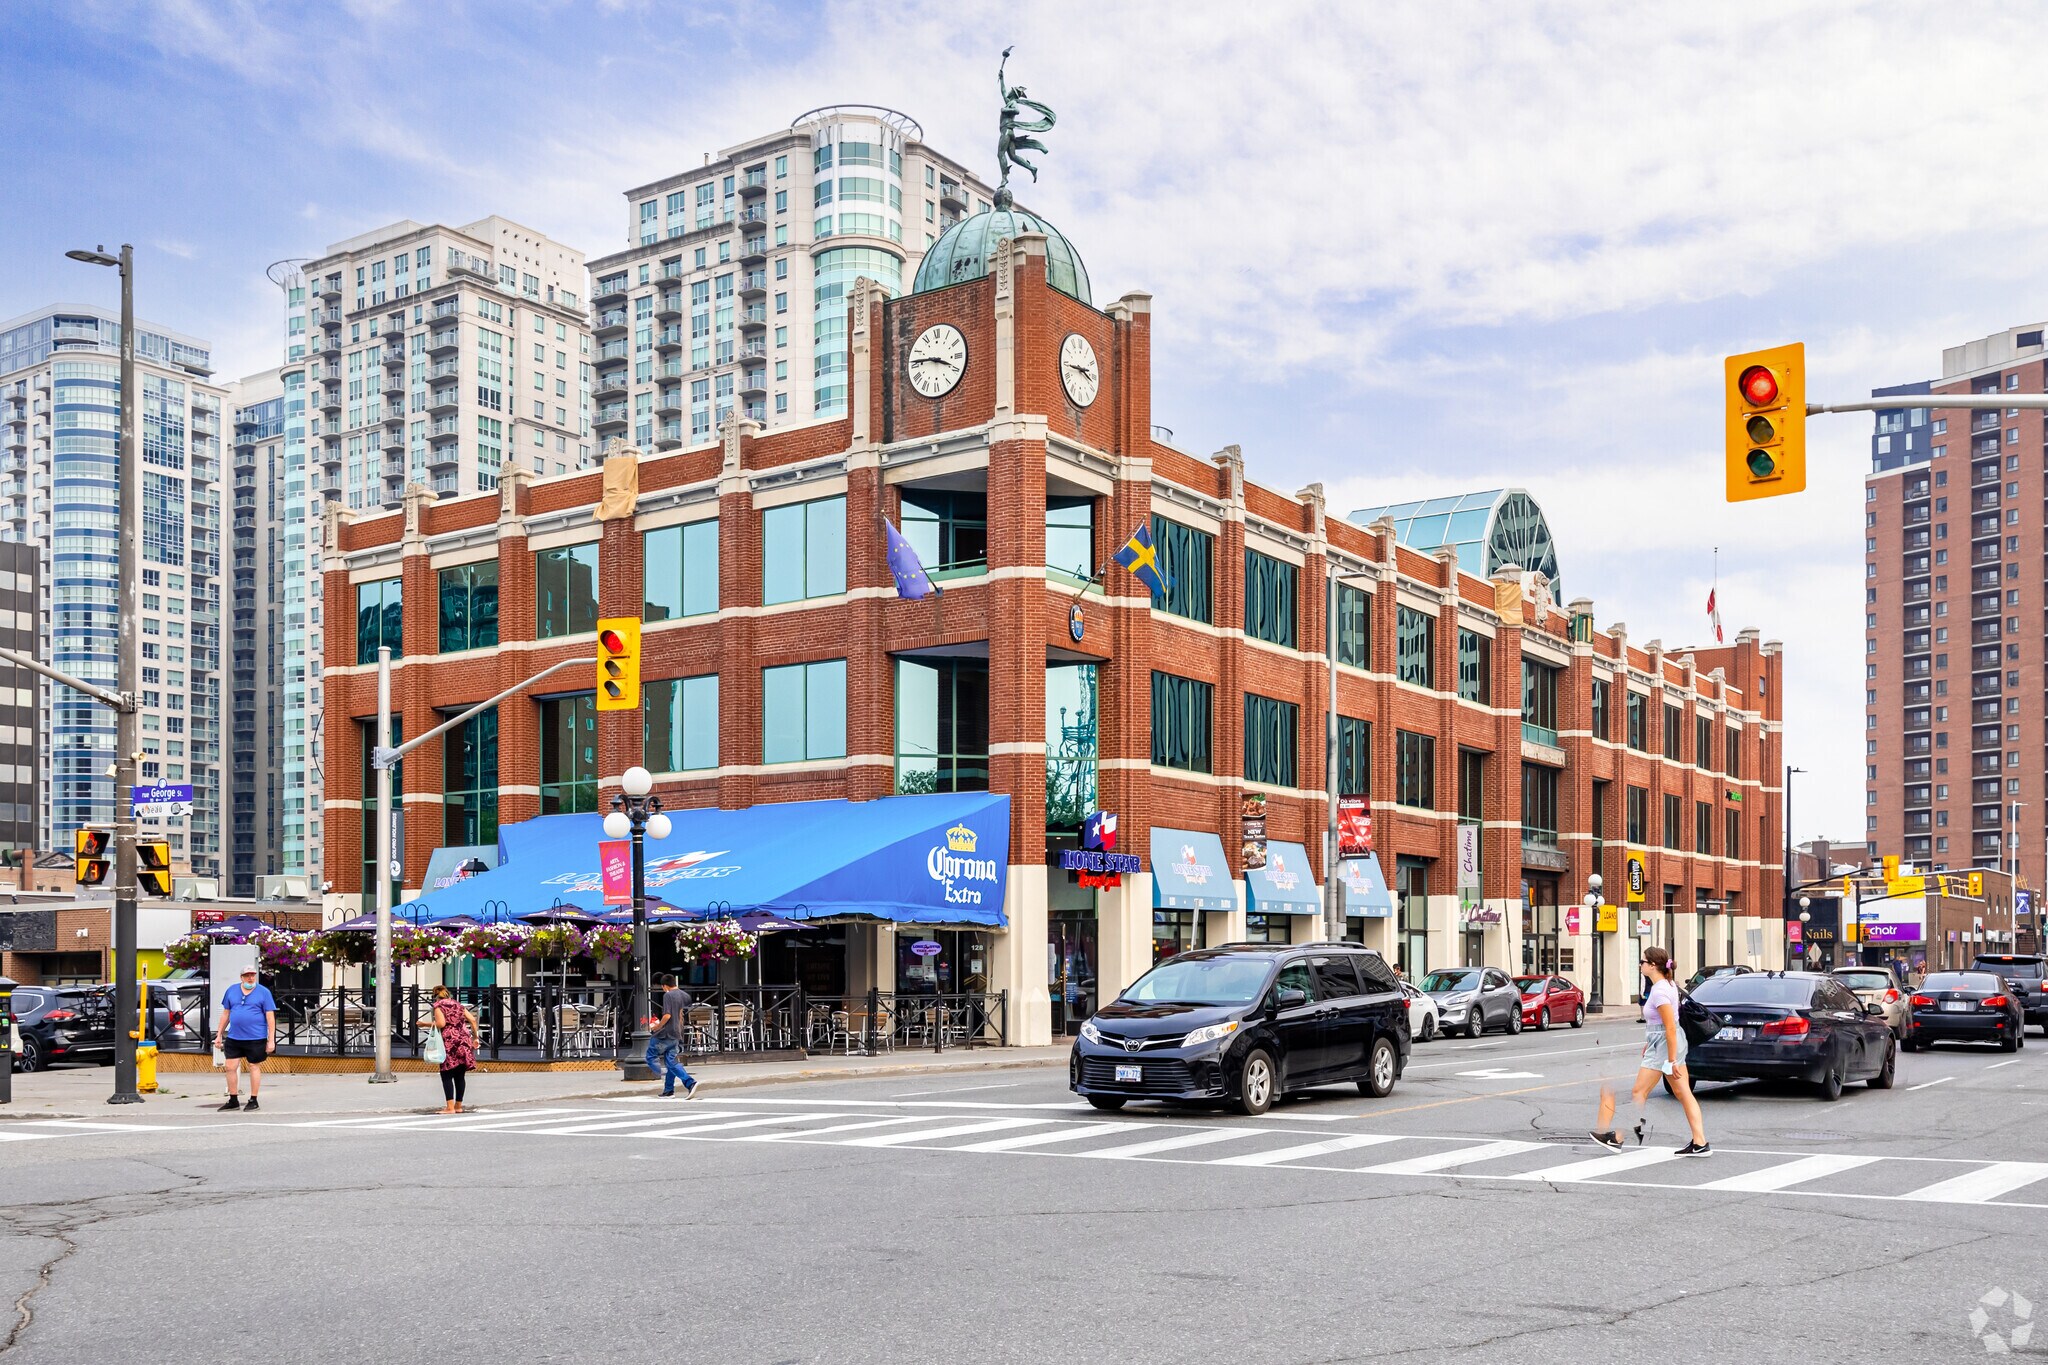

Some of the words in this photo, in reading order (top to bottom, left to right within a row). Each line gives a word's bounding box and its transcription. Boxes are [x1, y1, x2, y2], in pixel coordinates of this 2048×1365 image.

[151, 788, 176, 800] George
[1463, 830, 1473, 873] Chatime
[927, 846, 998, 885] Corona
[1064, 849, 1104, 872] LONE
[1104, 852, 1142, 875] STAR
[944, 878, 982, 905] Extra
[1469, 903, 1502, 923] Chatime
[1604, 911, 1617, 920] LOANS
[1805, 928, 1833, 940] Nails
[1869, 925, 1898, 935] chatr
